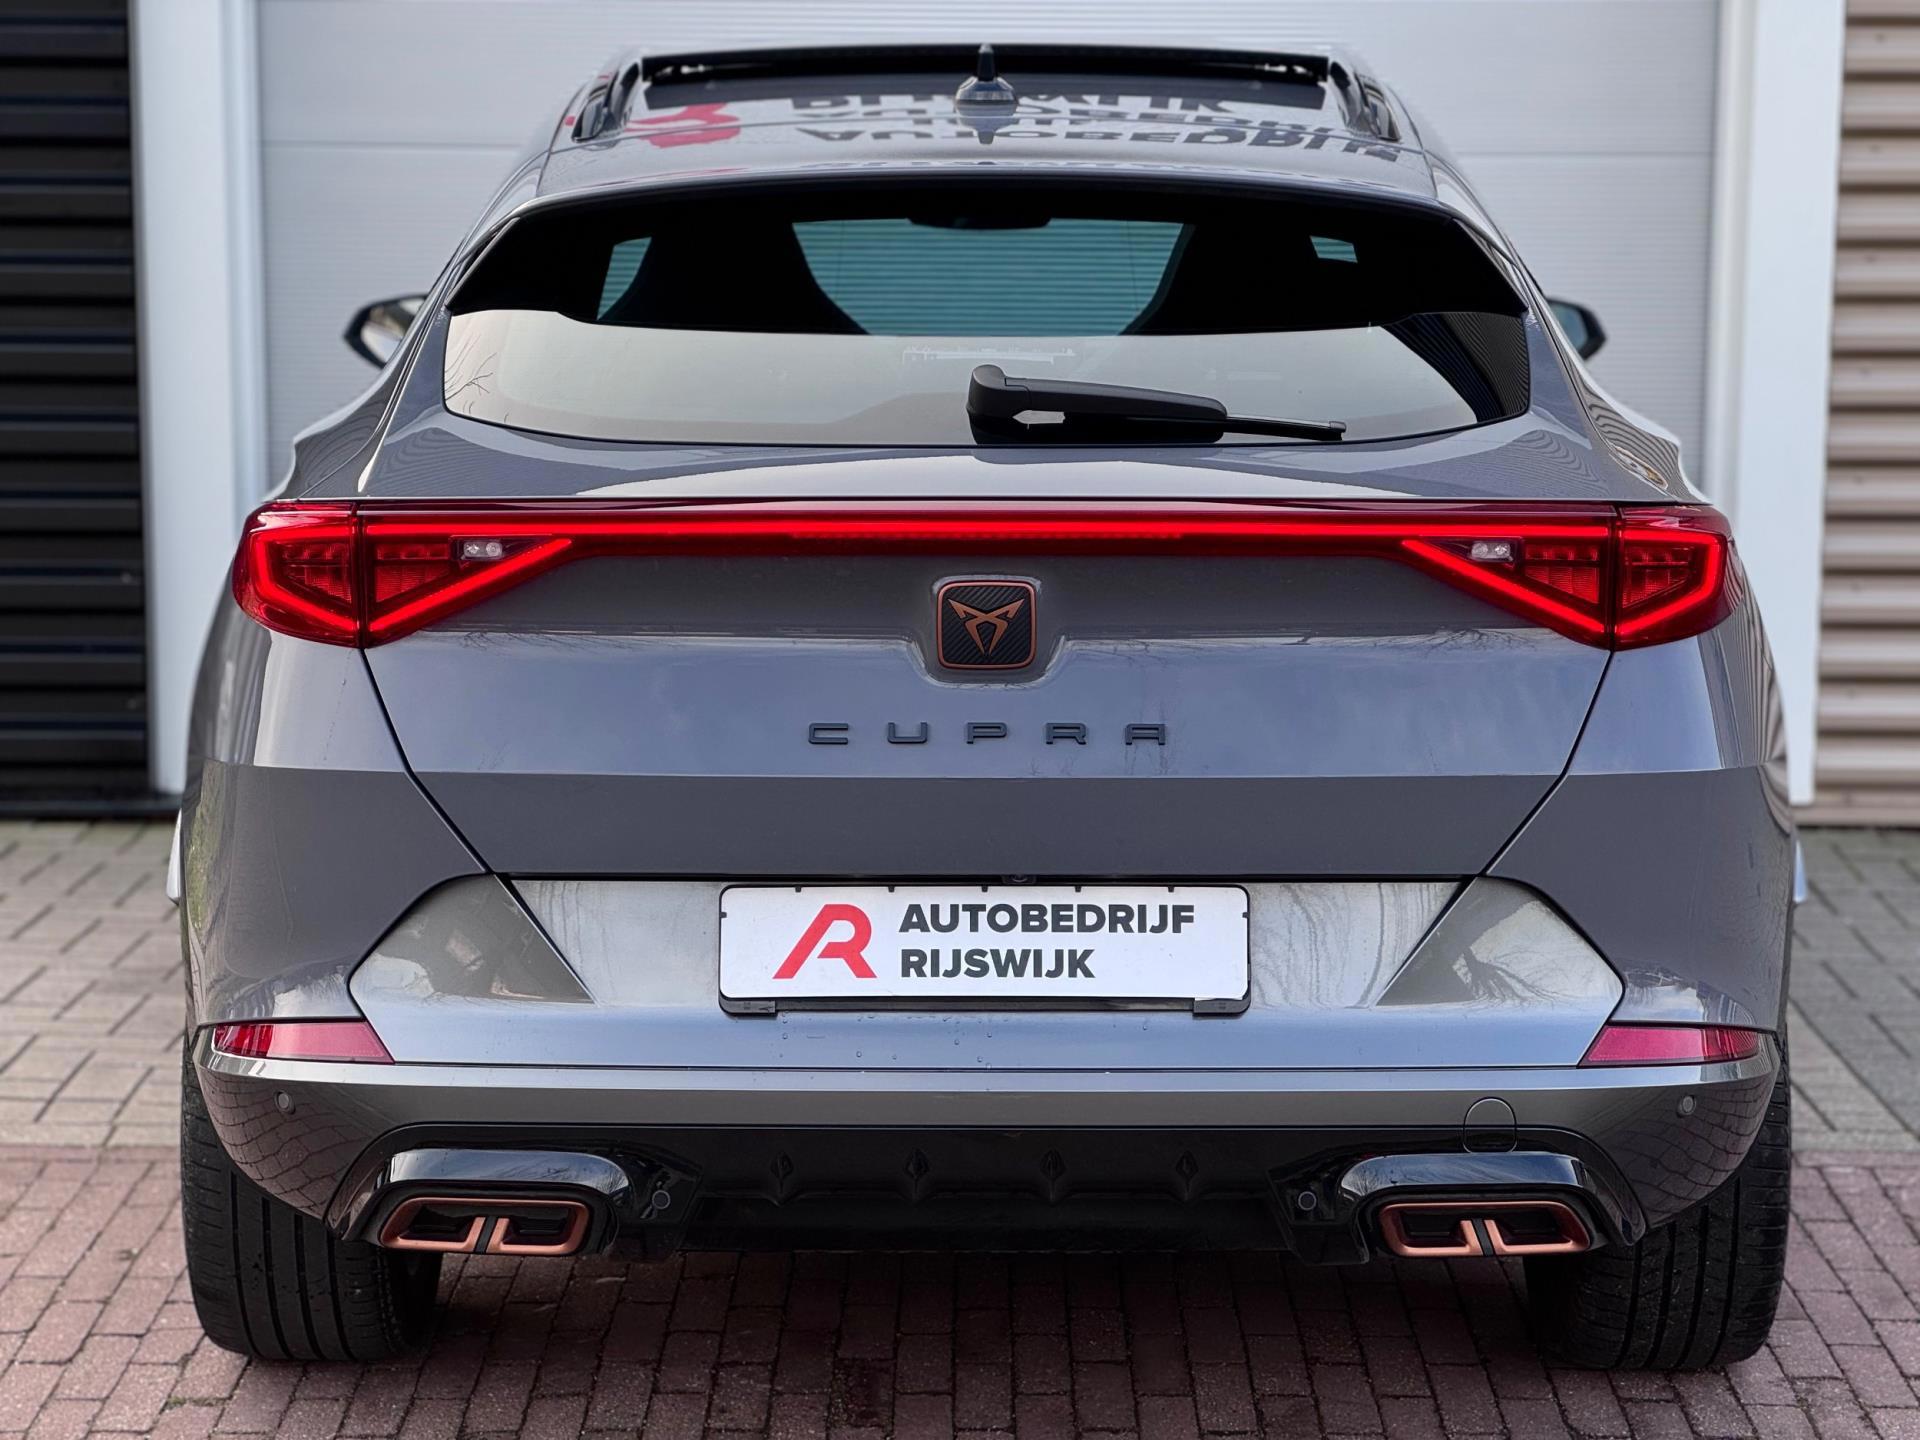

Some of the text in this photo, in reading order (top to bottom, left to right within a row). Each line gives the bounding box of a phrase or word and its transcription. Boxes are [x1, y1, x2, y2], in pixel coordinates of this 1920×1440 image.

[808, 721, 1166, 746] CUPRA
[898, 903, 1195, 934] AUTOBEDRIJF
[900, 948, 1096, 979] RIJSWIJK
